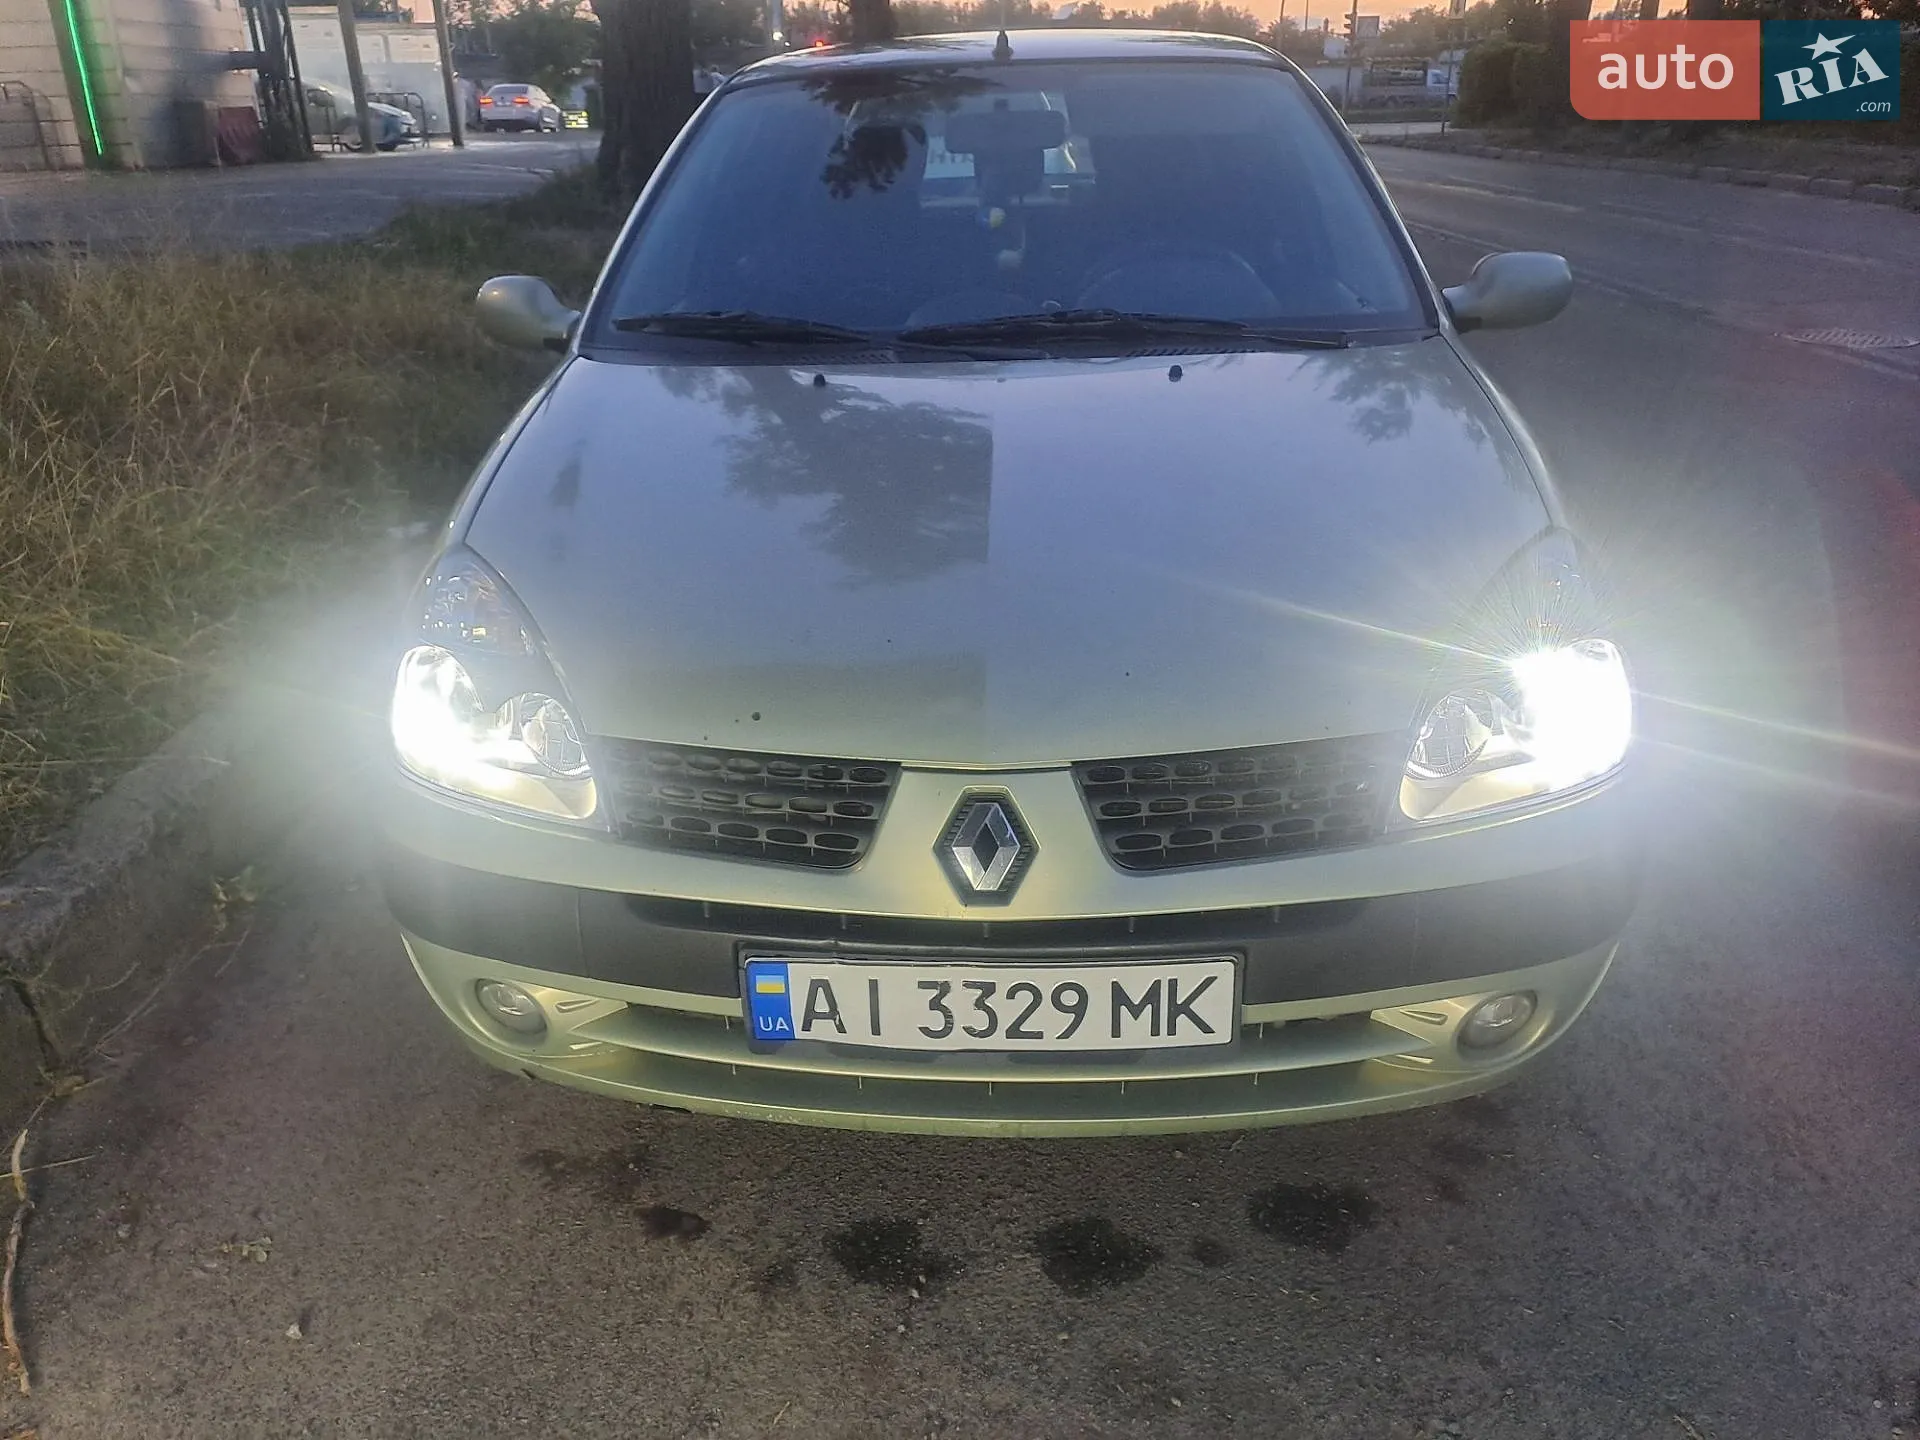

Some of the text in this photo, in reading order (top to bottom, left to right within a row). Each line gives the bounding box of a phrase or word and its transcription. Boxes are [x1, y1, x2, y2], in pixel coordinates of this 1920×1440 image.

[758, 1014, 789, 1032] UA
[801, 976, 1218, 1039] AI 3329 MK
